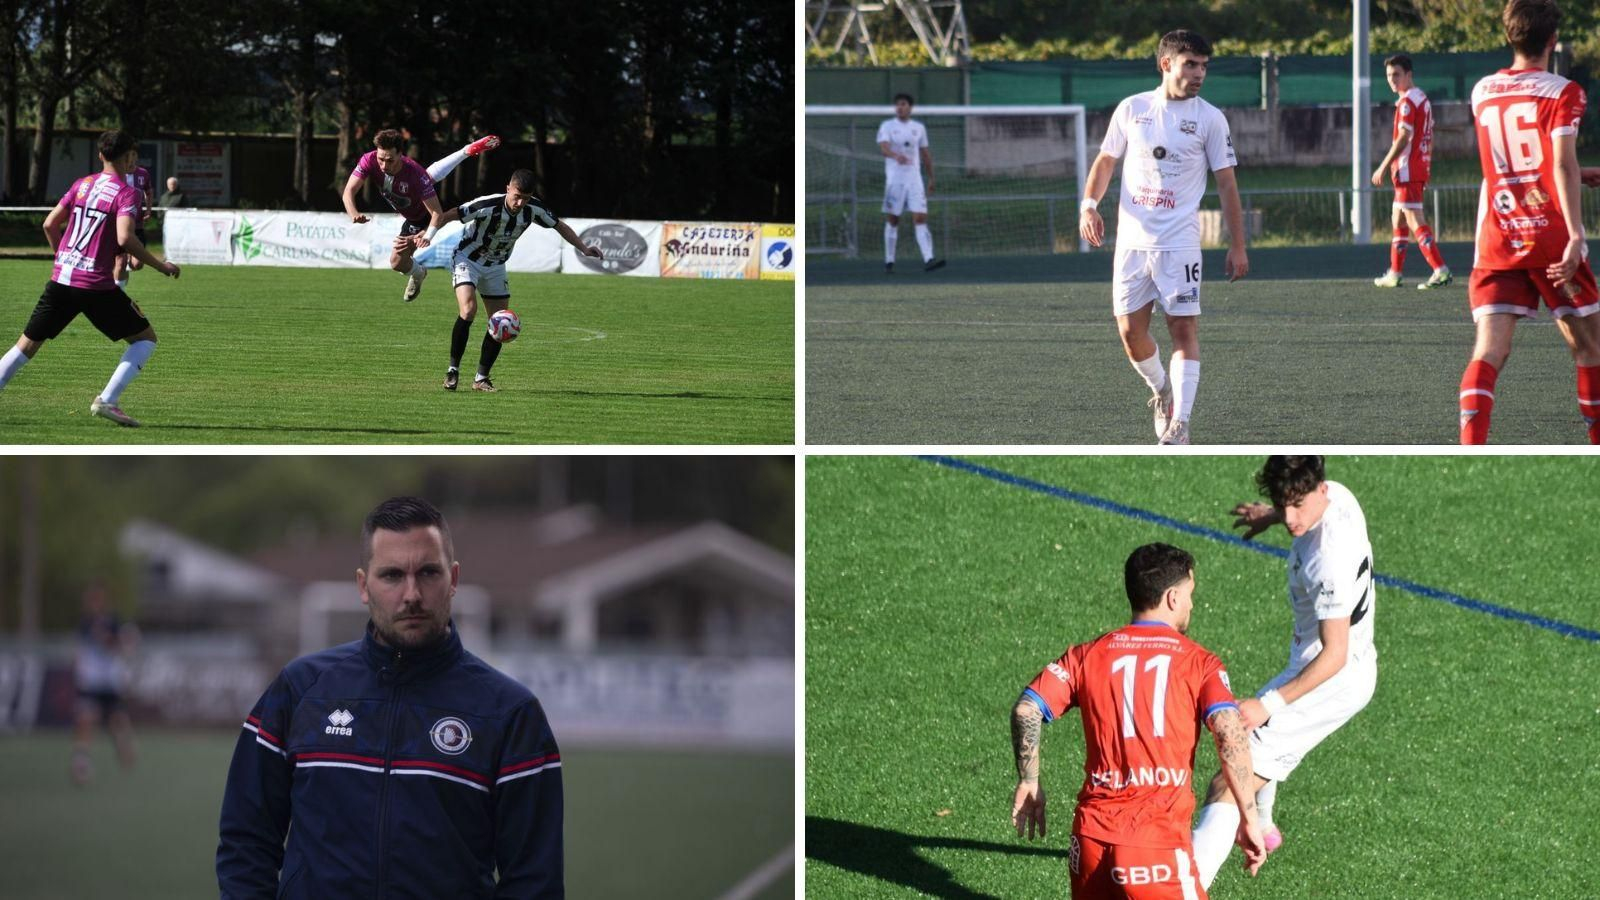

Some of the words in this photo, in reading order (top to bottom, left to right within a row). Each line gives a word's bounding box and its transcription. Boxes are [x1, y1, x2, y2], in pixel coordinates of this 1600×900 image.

[1479, 102, 1544, 175] 16
[67, 204, 109, 252] 17
[286, 221, 346, 239] PATATAS
[263, 243, 318, 259] CARLOS
[1185, 262, 1199, 283] 16
[1111, 654, 1172, 738] 11
[325, 725, 353, 736] errea
[1111, 864, 1172, 885] GBD
